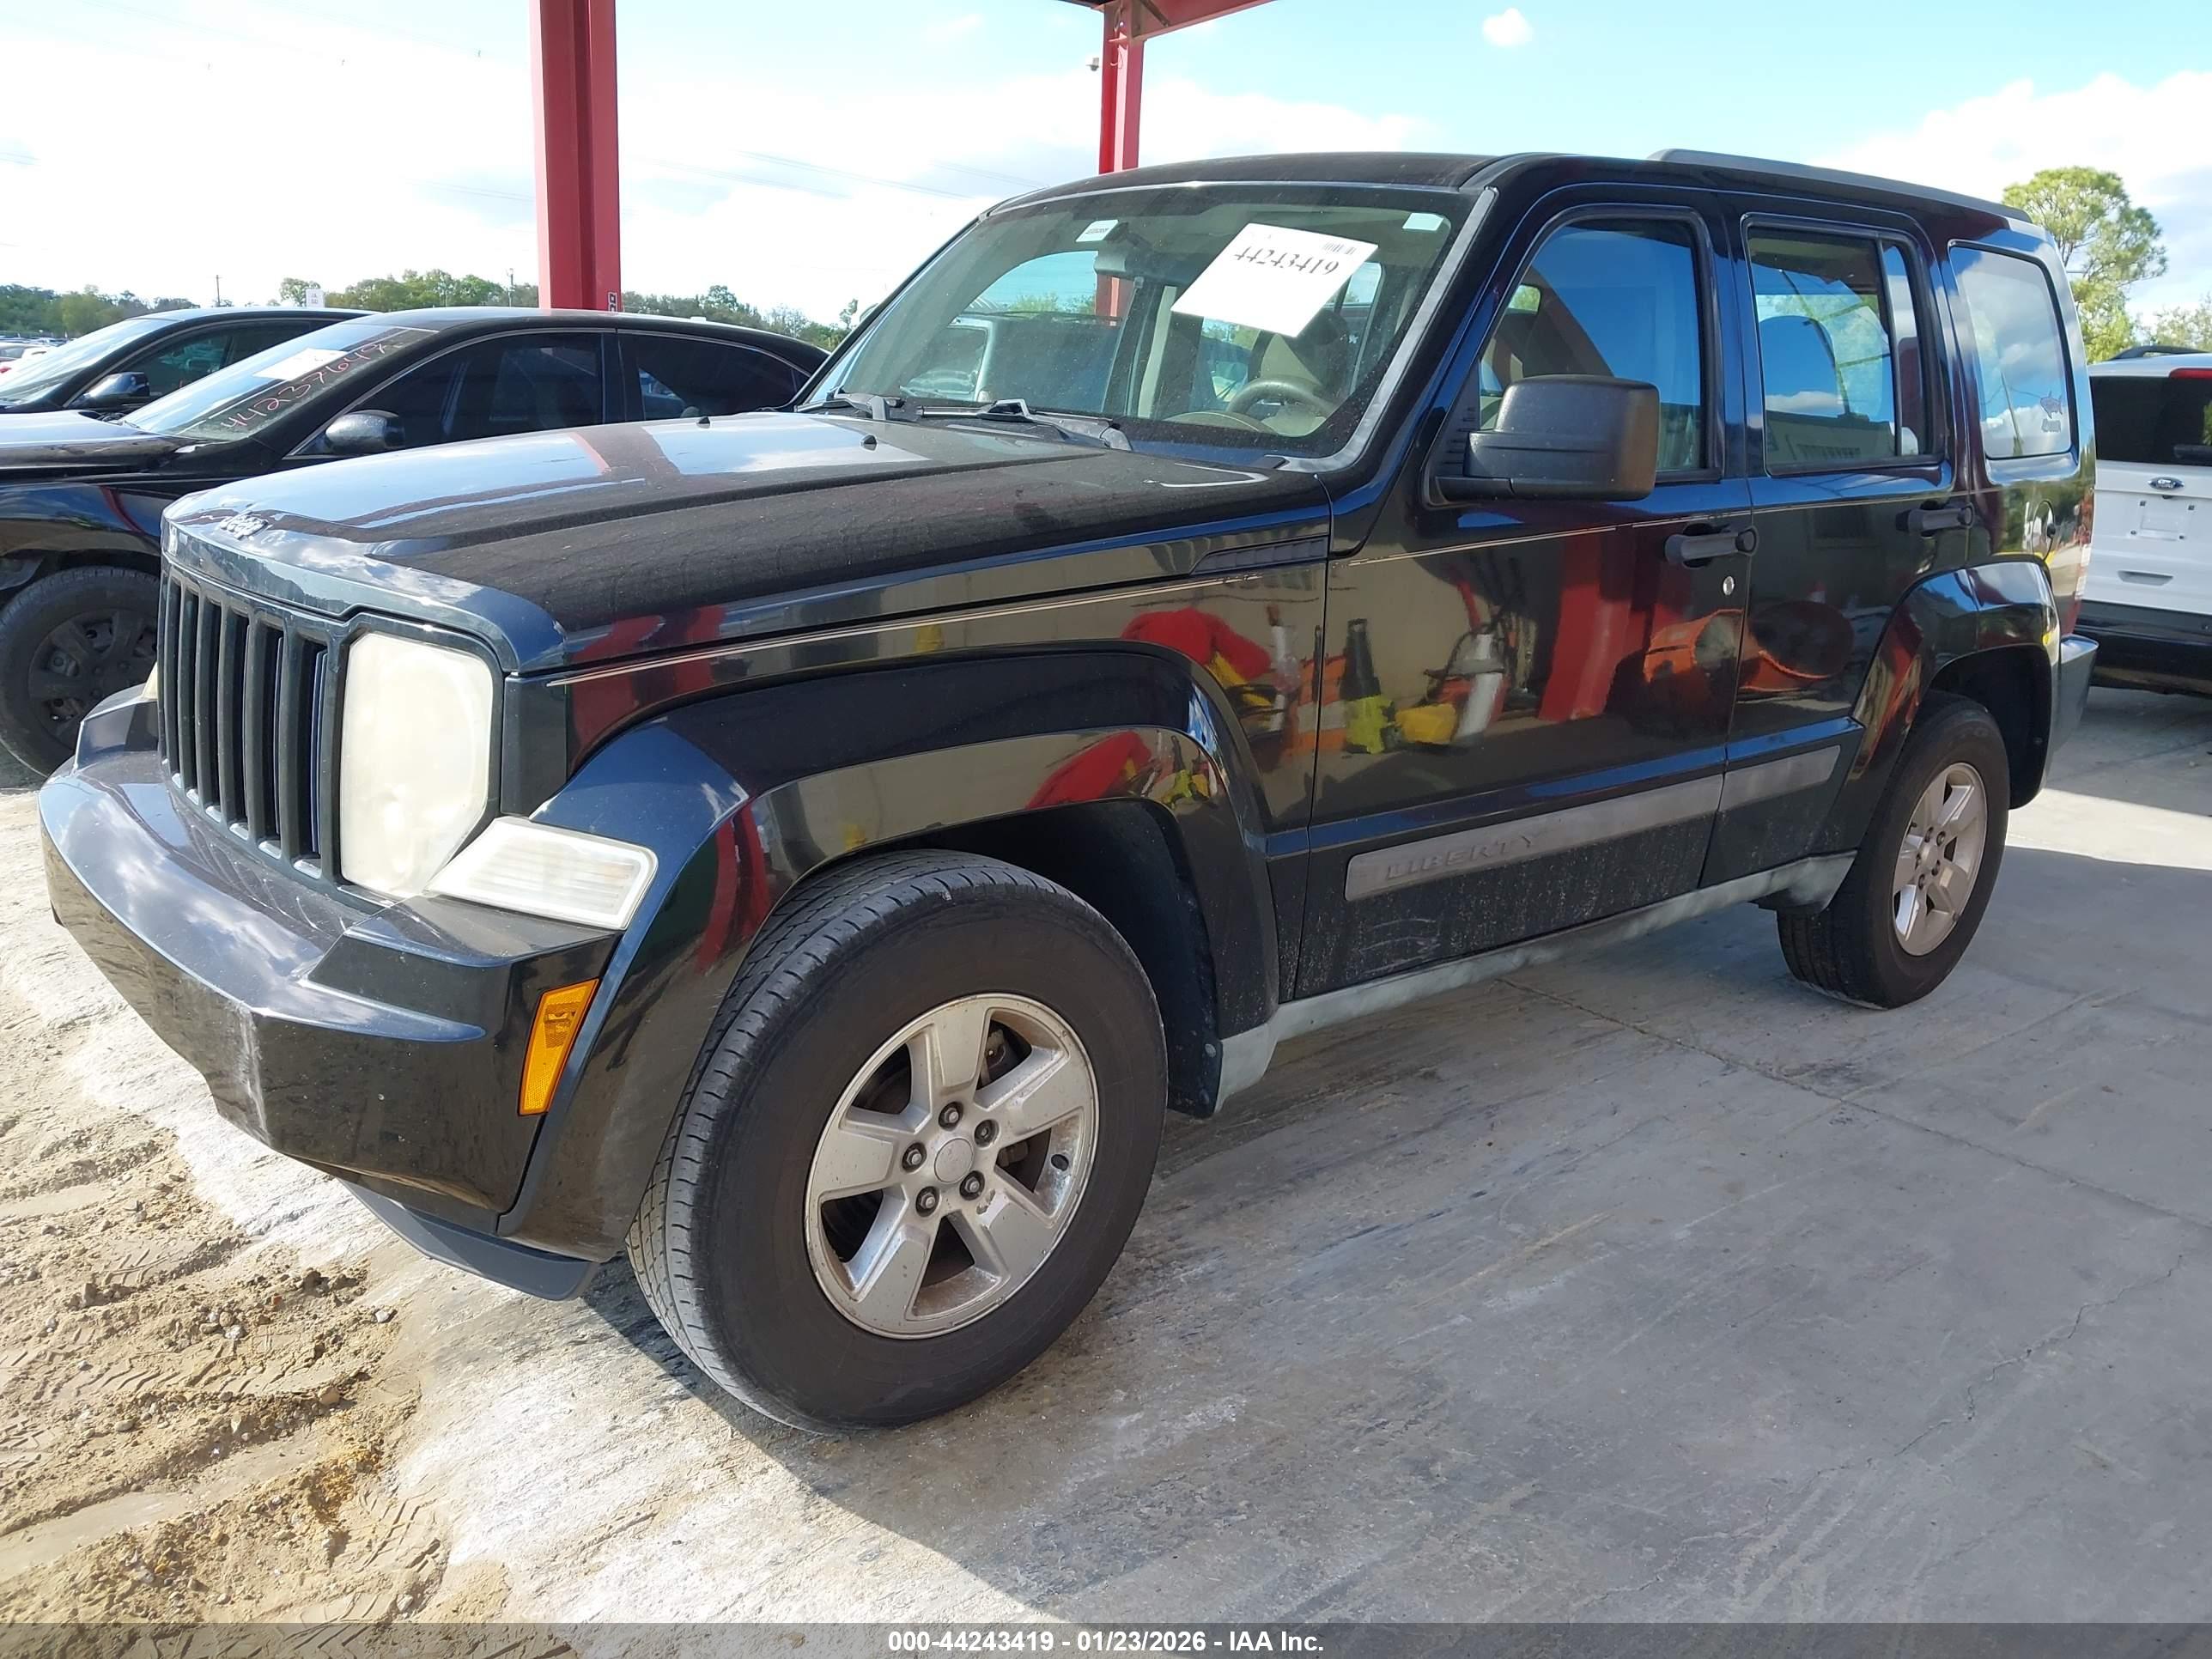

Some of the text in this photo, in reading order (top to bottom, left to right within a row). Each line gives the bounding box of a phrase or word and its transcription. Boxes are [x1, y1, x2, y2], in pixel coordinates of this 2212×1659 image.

[1234, 246, 1340, 276] 44243419
[220, 343, 387, 428] 44237649
[1386, 830, 1543, 879] LIBERTY
